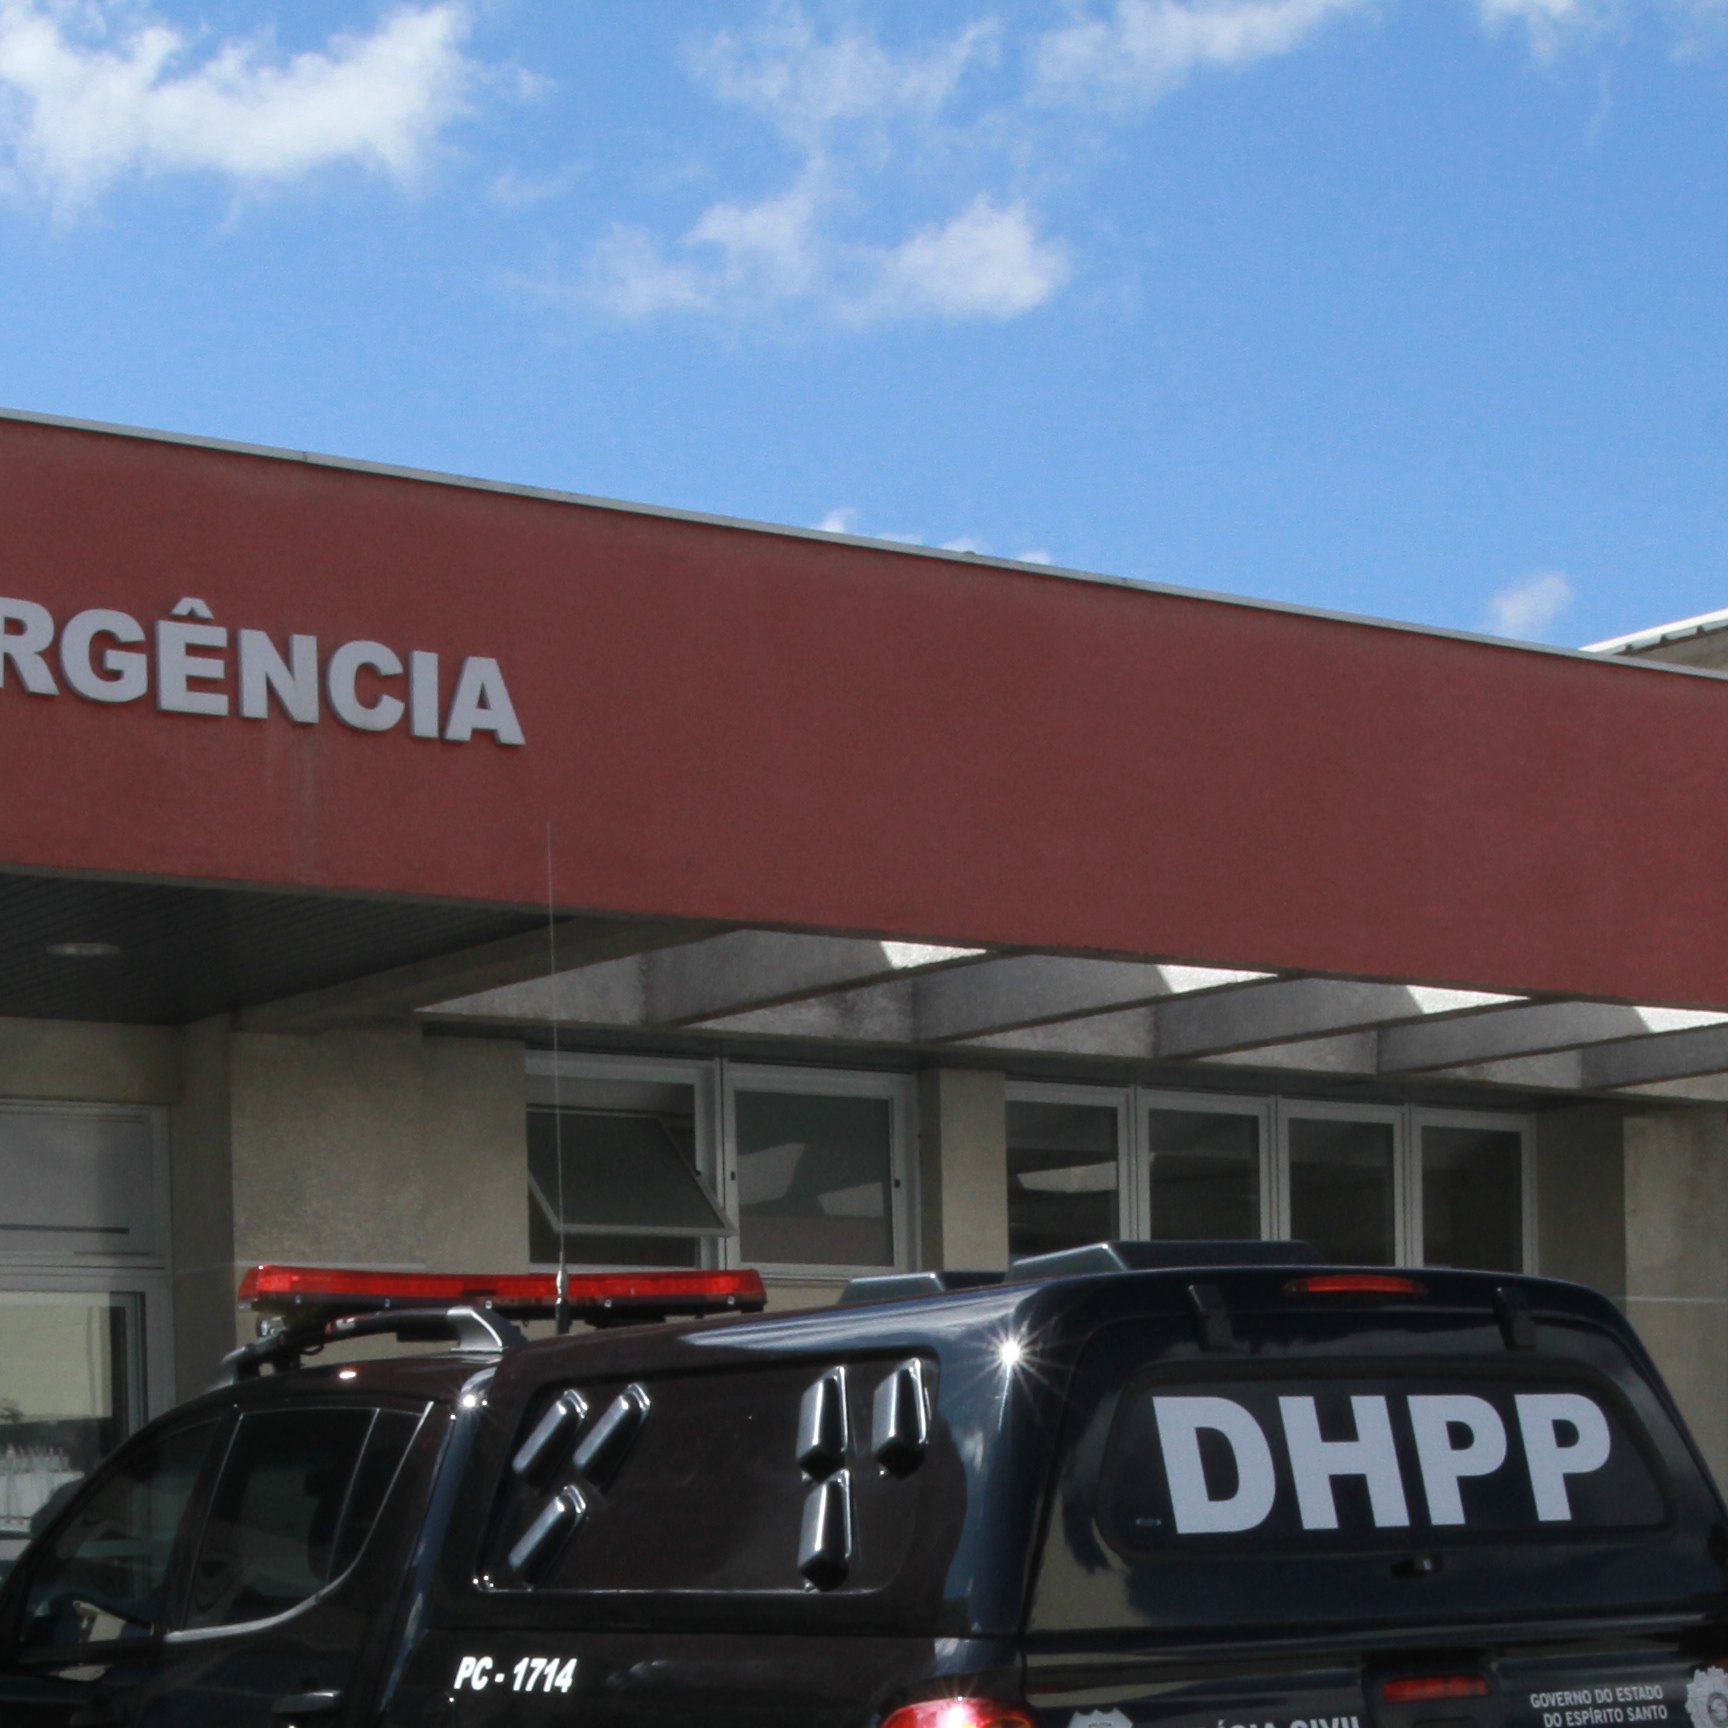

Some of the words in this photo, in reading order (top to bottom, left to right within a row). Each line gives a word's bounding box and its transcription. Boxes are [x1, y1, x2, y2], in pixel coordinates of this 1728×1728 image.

[1152, 1393, 1611, 1534] DHPP
[453, 1656, 493, 1690] PC
[513, 1657, 578, 1693] 1714
[1530, 1691, 1591, 1708] GOVERNO
[1594, 1688, 1613, 1704] DO
[1615, 1685, 1664, 1702] ESTADO
[1543, 1712, 1562, 1728] DO
[1565, 1706, 1623, 1727] ESPÍRITO
[1626, 1704, 1668, 1722] SANTO
